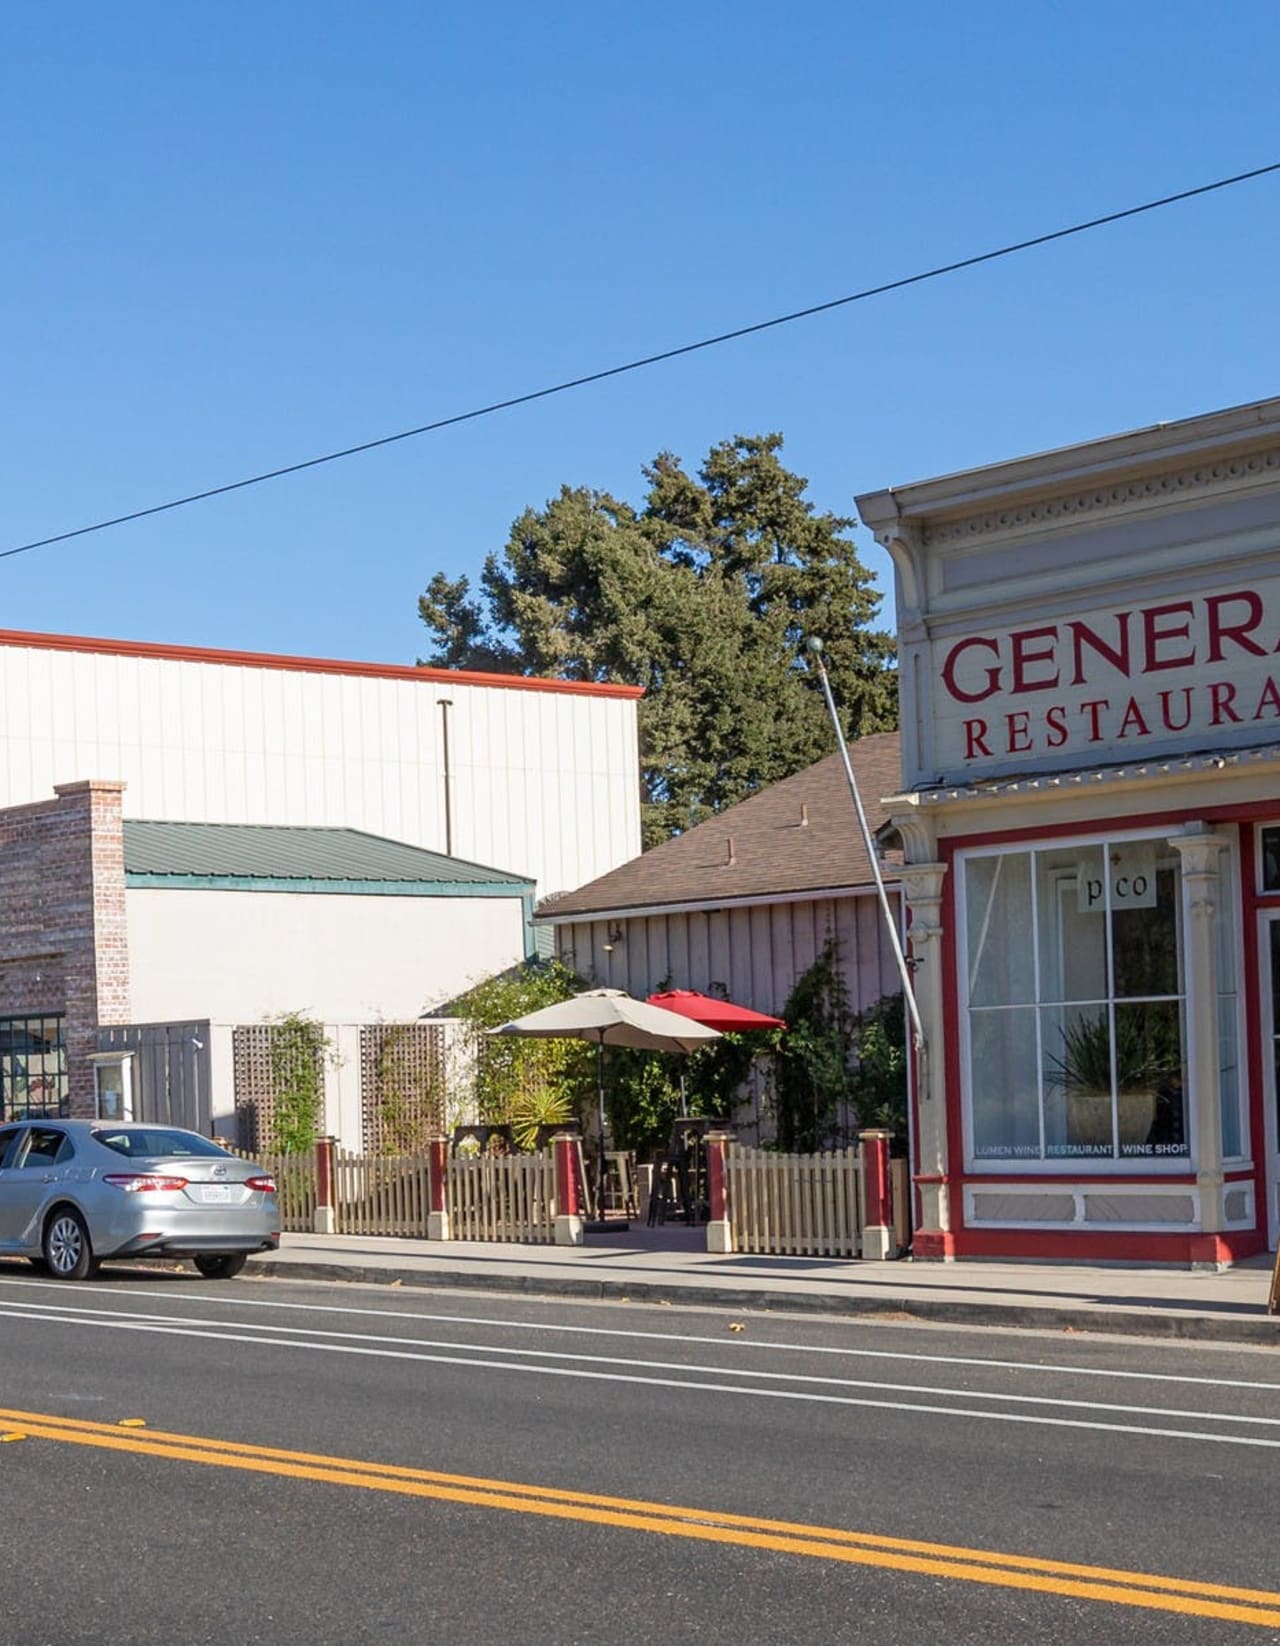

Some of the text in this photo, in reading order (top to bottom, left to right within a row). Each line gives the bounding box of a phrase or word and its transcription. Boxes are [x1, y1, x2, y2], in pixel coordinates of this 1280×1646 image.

[1087, 875, 1148, 906] pco
[1047, 1143, 1114, 1155] RESTAURANT
[1121, 1143, 1154, 1155] WINE
[1154, 1142, 1189, 1154] SHOP
